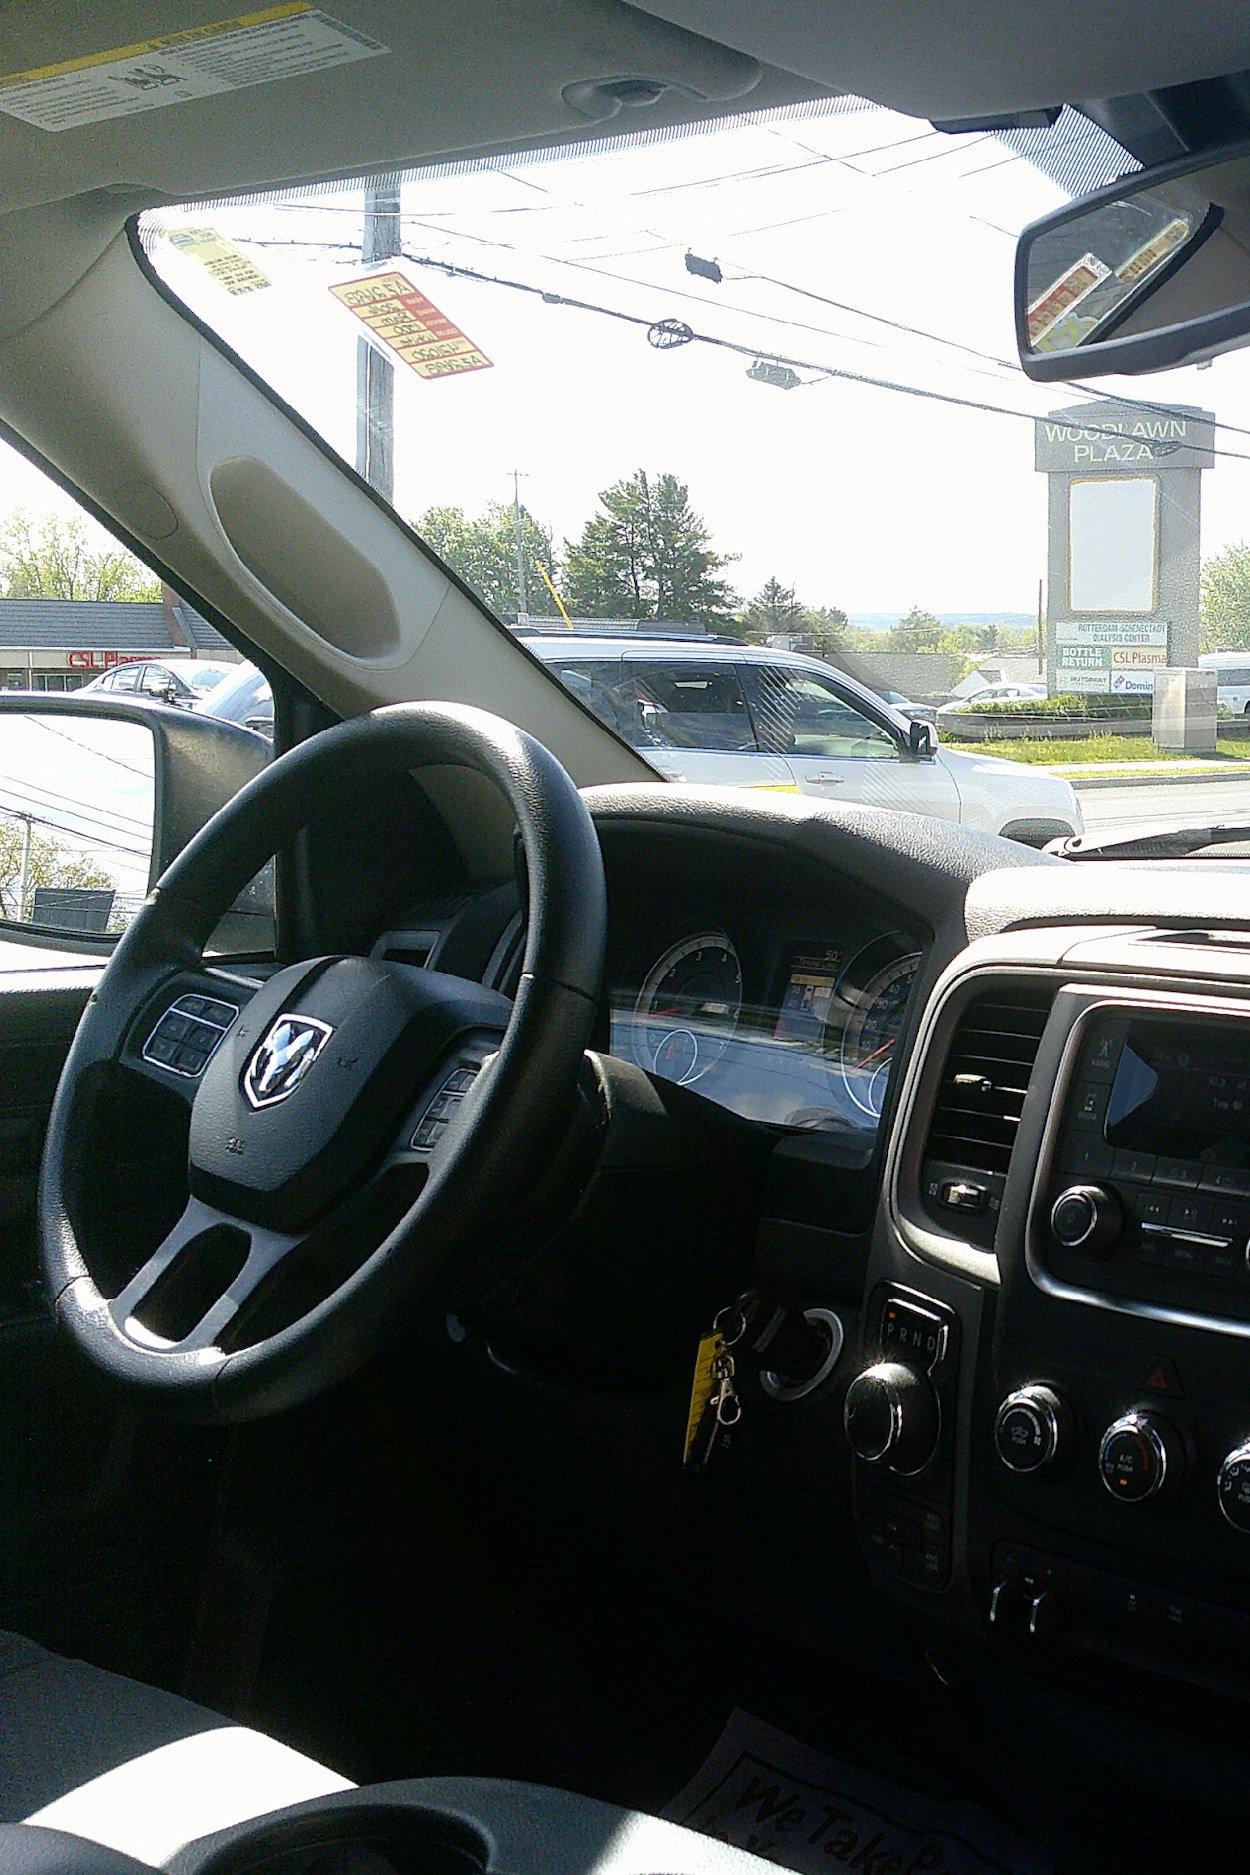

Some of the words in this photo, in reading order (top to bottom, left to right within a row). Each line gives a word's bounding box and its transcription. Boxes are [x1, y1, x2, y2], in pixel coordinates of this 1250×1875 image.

[1045, 420, 1187, 442] WOODLAWN
[1074, 444, 1154, 463] PLAZA
[1124, 633, 1151, 643] CENTER
[1062, 647, 1103, 657] BOTTLE
[1113, 652, 1131, 664] CSL
[1132, 651, 1168, 664] Plasma
[68, 651, 99, 669] CSL
[1061, 657, 1103, 667] RETURN
[1126, 680, 1153, 690] Domin
[888, 1322, 894, 1333] P
[900, 1327, 908, 1342] R
[913, 1331, 922, 1347] N
[927, 1336, 936, 1351] D
